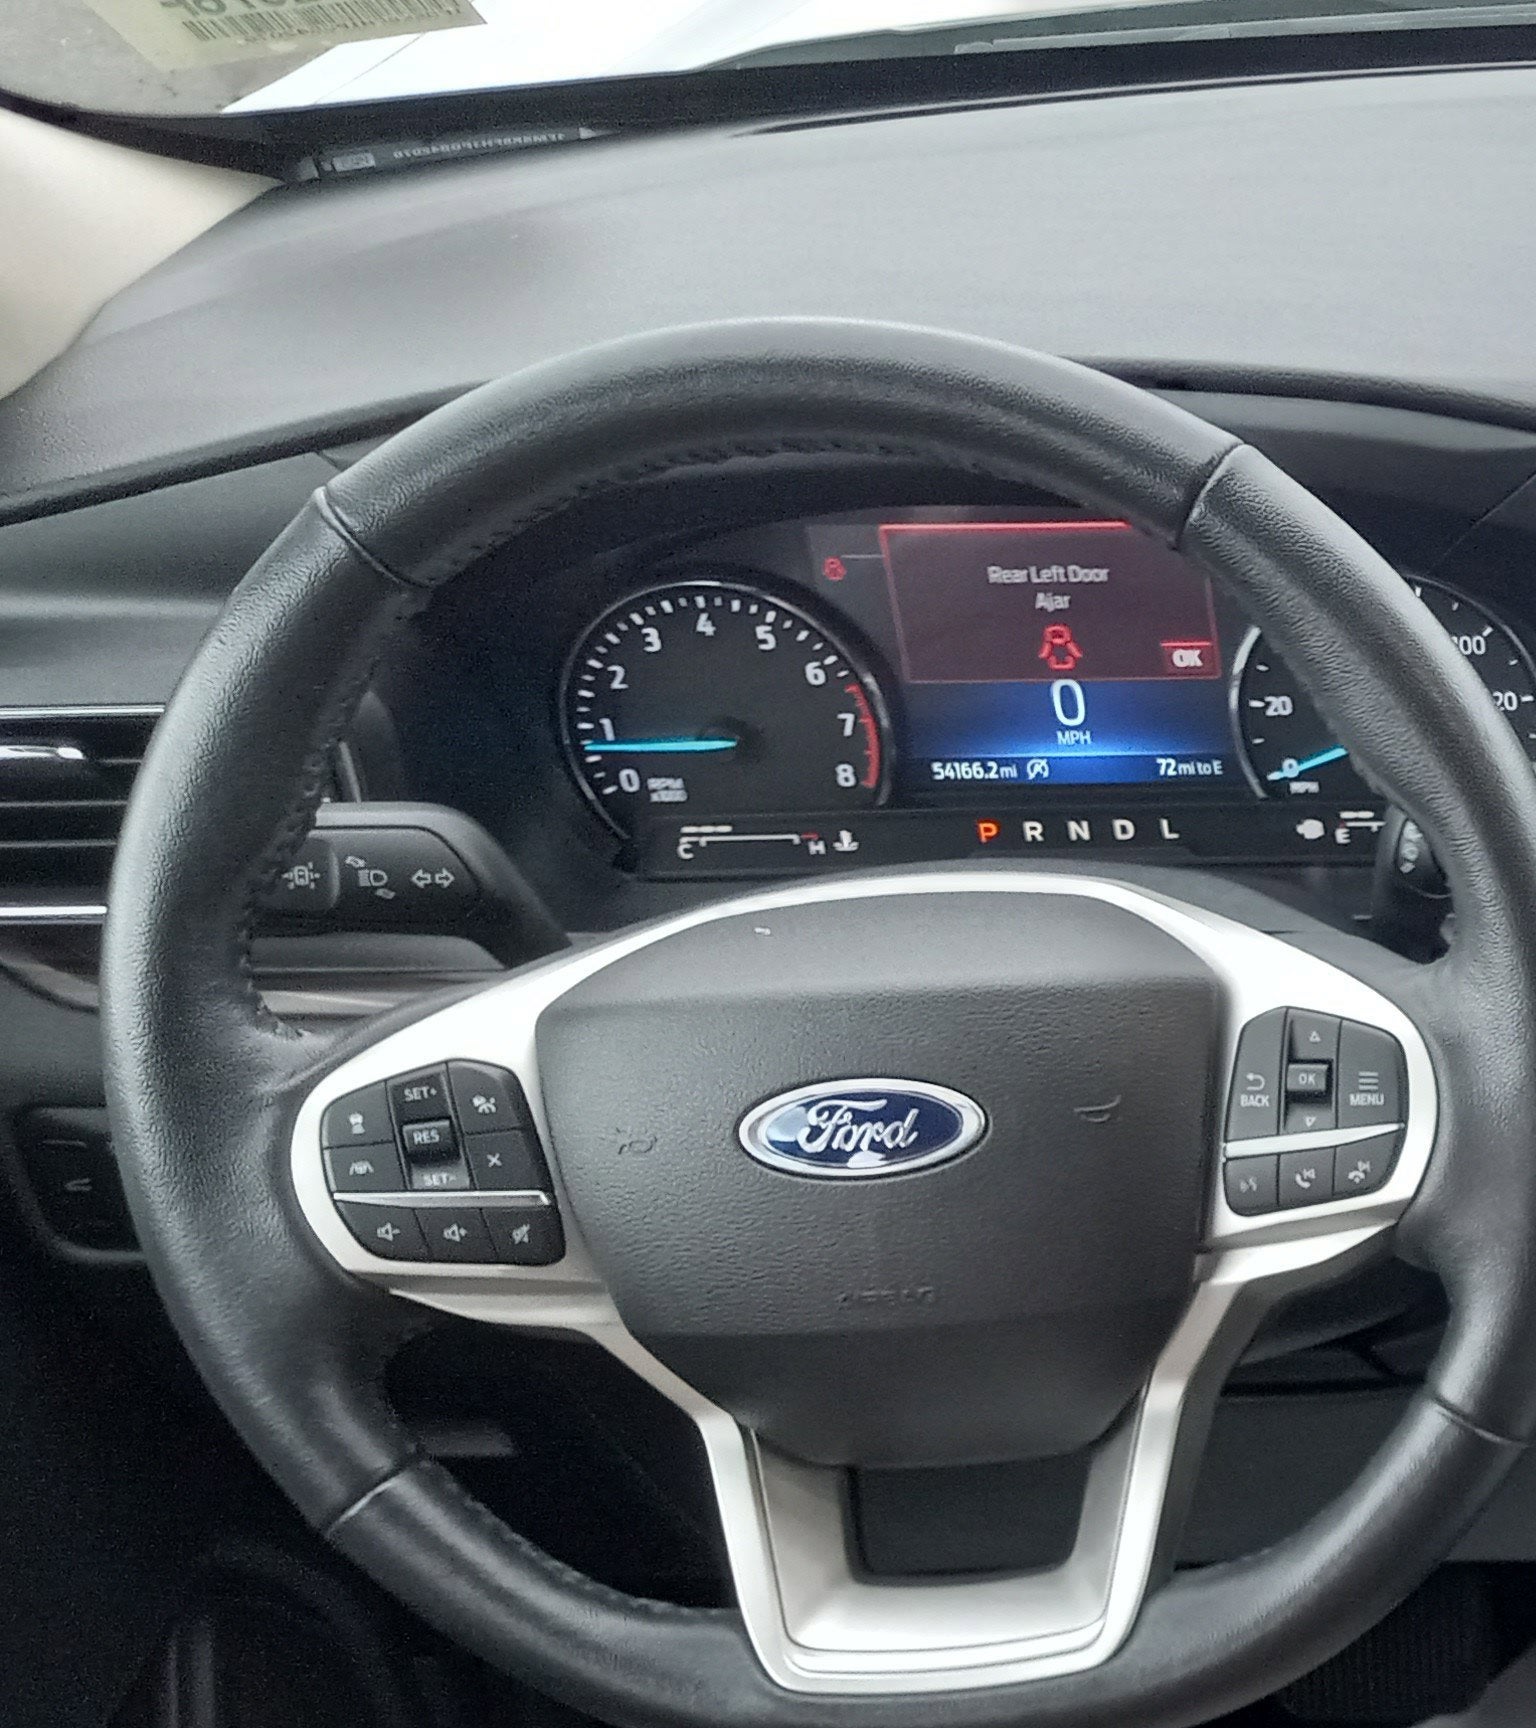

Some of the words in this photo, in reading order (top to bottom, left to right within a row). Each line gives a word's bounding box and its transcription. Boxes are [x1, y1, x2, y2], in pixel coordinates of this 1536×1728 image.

[987, 565, 1028, 584] Rear
[1030, 565, 1066, 584] Left
[1067, 565, 1109, 583] Door
[1035, 593, 1071, 612] Ajar
[695, 613, 716, 637] 4
[641, 627, 662, 652] 3
[755, 626, 776, 651] 5
[1452, 635, 1487, 655] 00
[1172, 649, 1203, 668] OK
[607, 665, 629, 690] 2
[805, 661, 826, 686] 6
[1051, 678, 1086, 727] 0
[1264, 696, 1294, 716] 20
[1492, 691, 1518, 711] 20
[599, 718, 615, 741] 1
[837, 713, 856, 736] 7
[1056, 730, 1092, 746] MPH
[835, 763, 857, 788] 8
[1156, 758, 1177, 776] 72
[619, 768, 640, 793] 0
[977, 821, 999, 844] P
[1022, 820, 1045, 842] R
[1067, 819, 1091, 841] N
[1112, 818, 1136, 840] D
[1159, 818, 1180, 839] L
[1335, 827, 1351, 844] E
[677, 843, 695, 860] C
[808, 841, 826, 856] H
[1299, 1072, 1317, 1086] OK
[1240, 1094, 1270, 1108] BACK
[1349, 1093, 1385, 1107] MENU
[797, 1098, 919, 1153] Ford
[412, 1128, 440, 1145] RES
